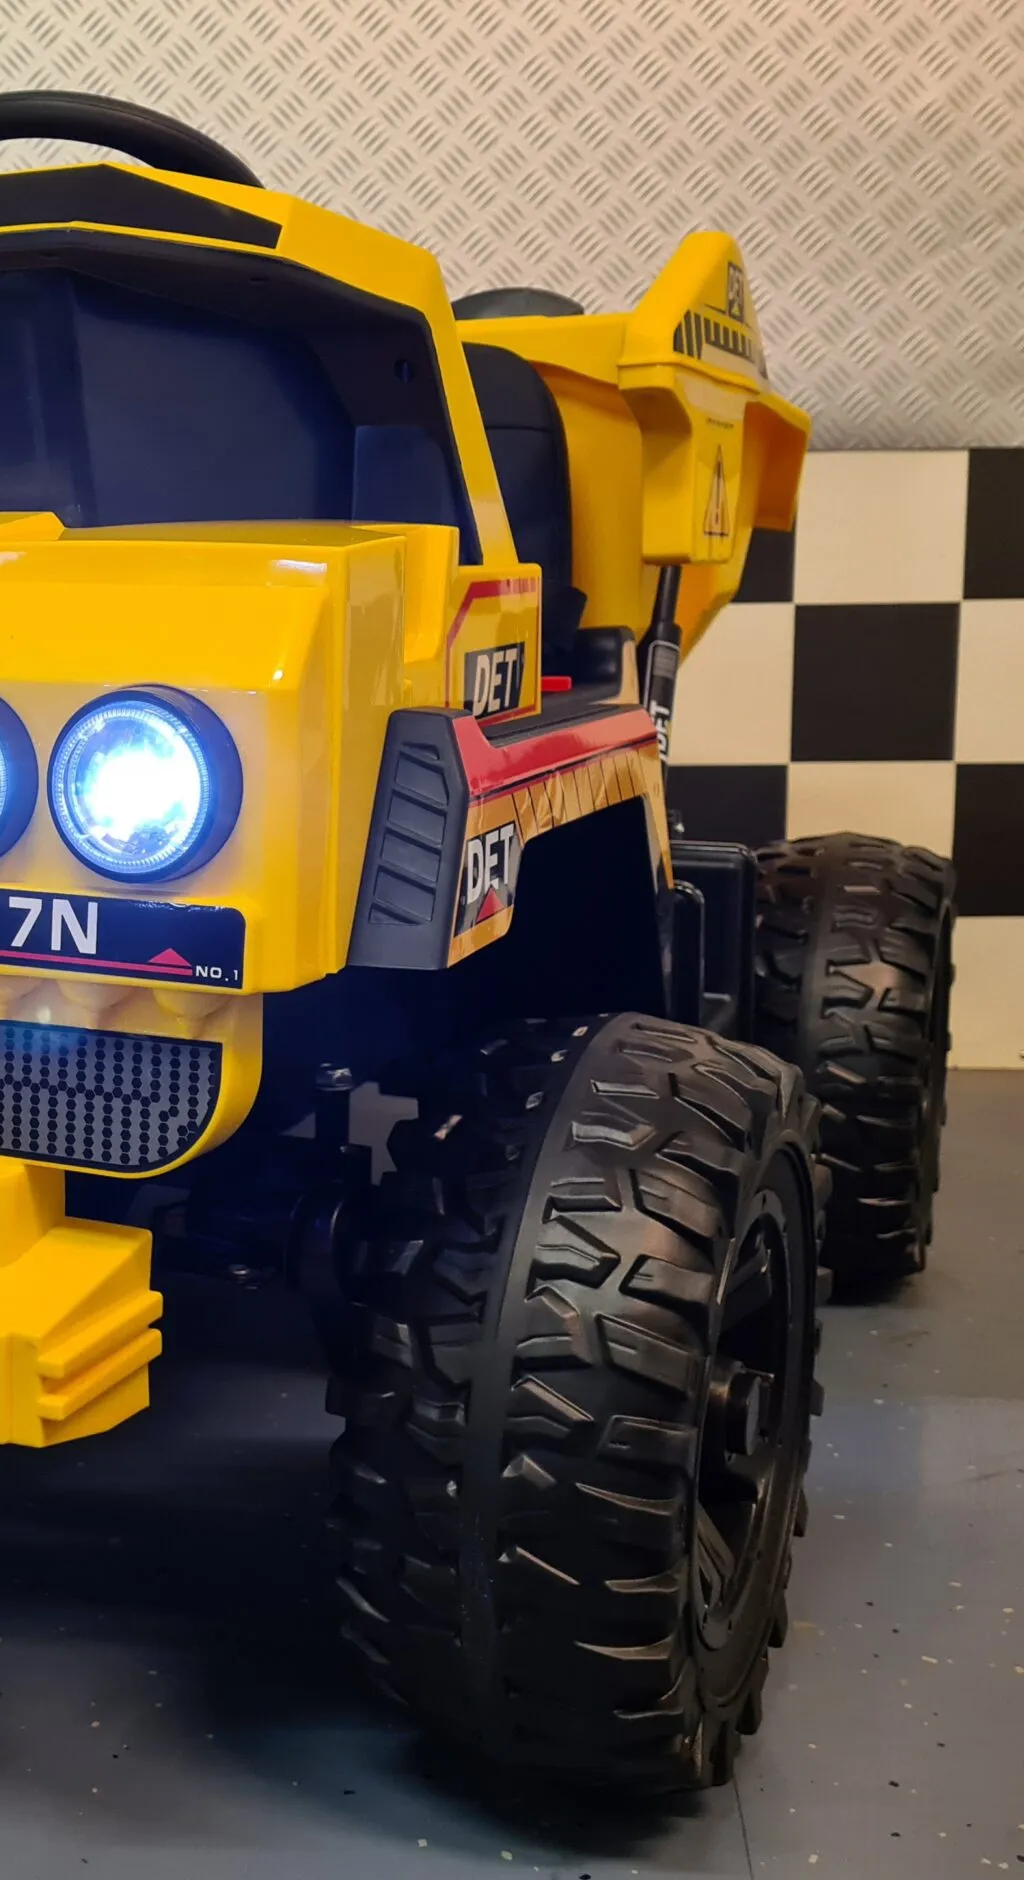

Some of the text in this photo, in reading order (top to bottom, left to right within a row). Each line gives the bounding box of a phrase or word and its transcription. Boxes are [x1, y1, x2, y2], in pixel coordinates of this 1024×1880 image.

[472, 647, 518, 716] DET
[467, 823, 515, 905] DET
[195, 965, 238, 982] NO.1
